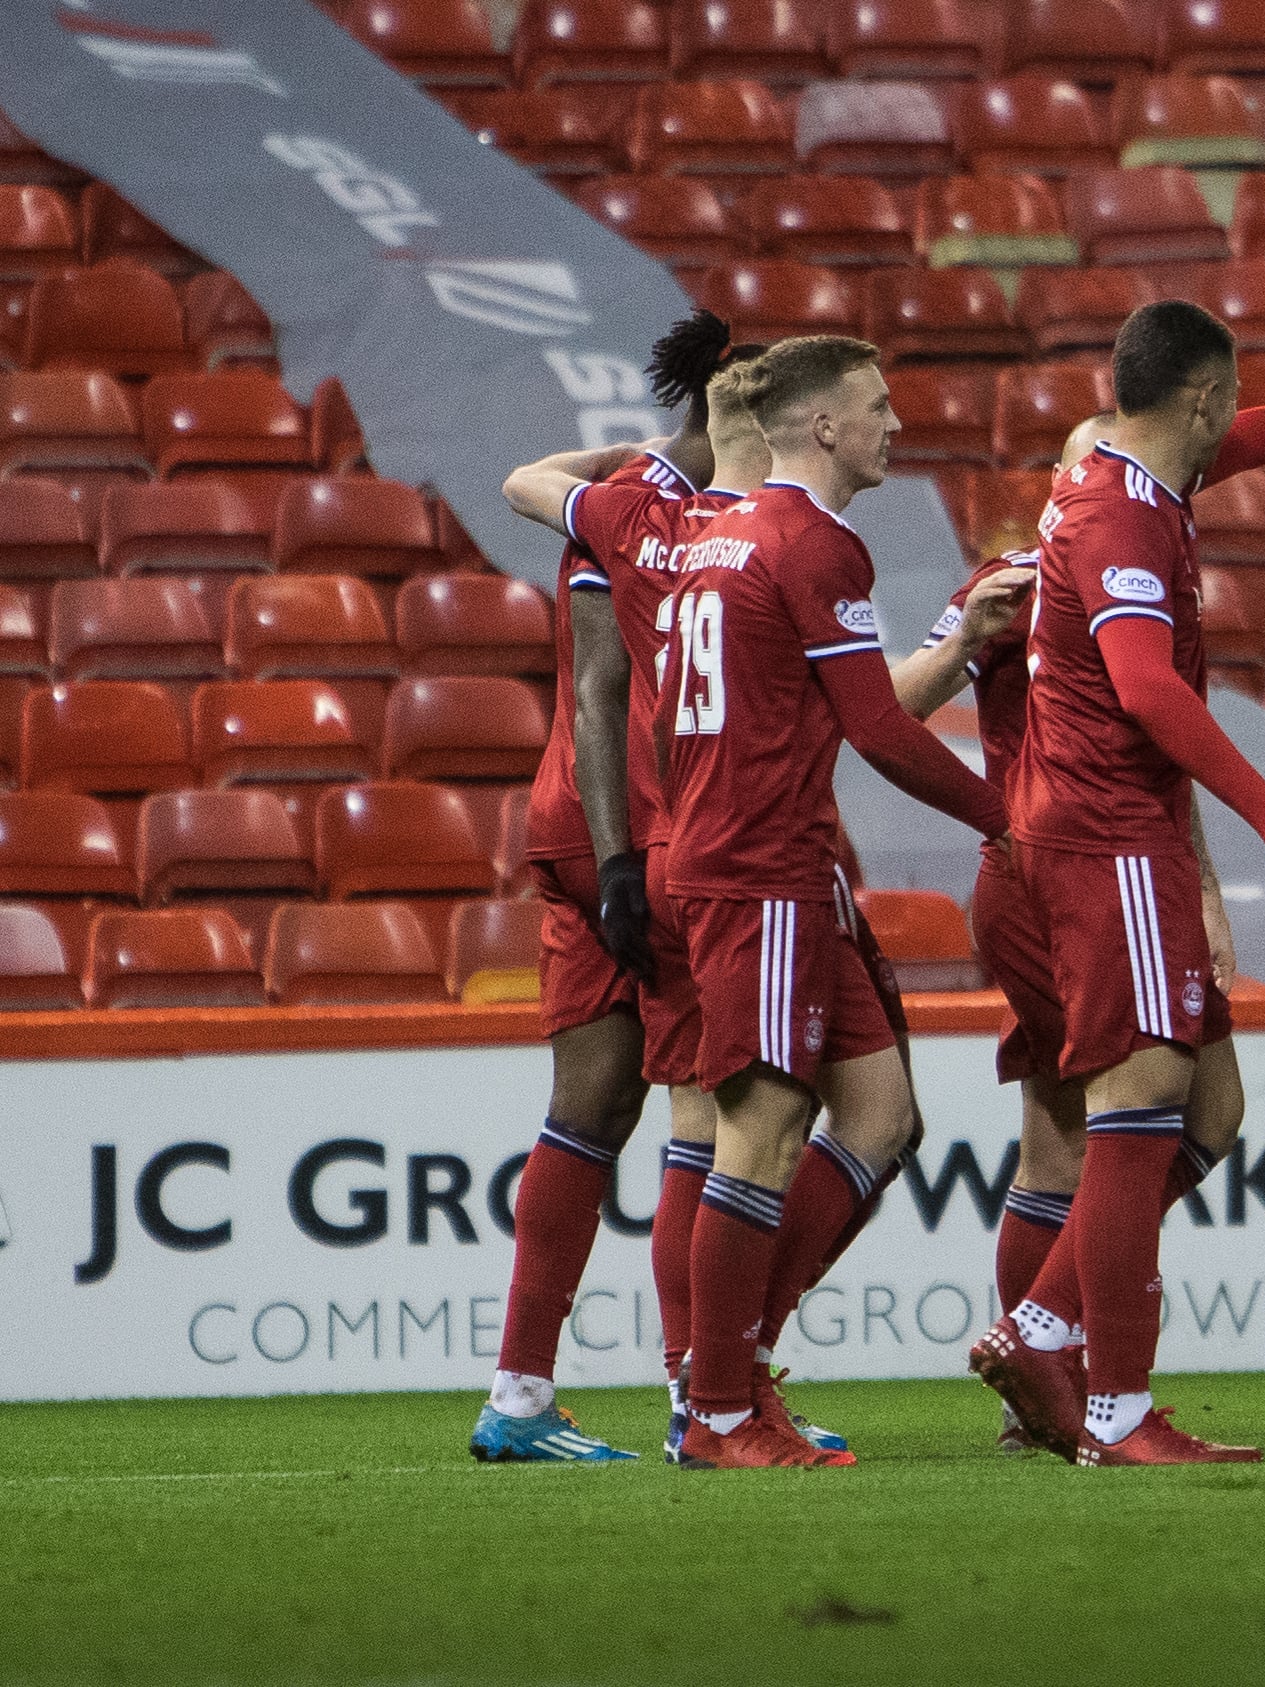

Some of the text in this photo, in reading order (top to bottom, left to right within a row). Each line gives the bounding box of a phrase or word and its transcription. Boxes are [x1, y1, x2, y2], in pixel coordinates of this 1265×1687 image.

[1118, 576, 1158, 592] cinch
[674, 590, 725, 736] 19
[74, 1140, 233, 1285] JC
